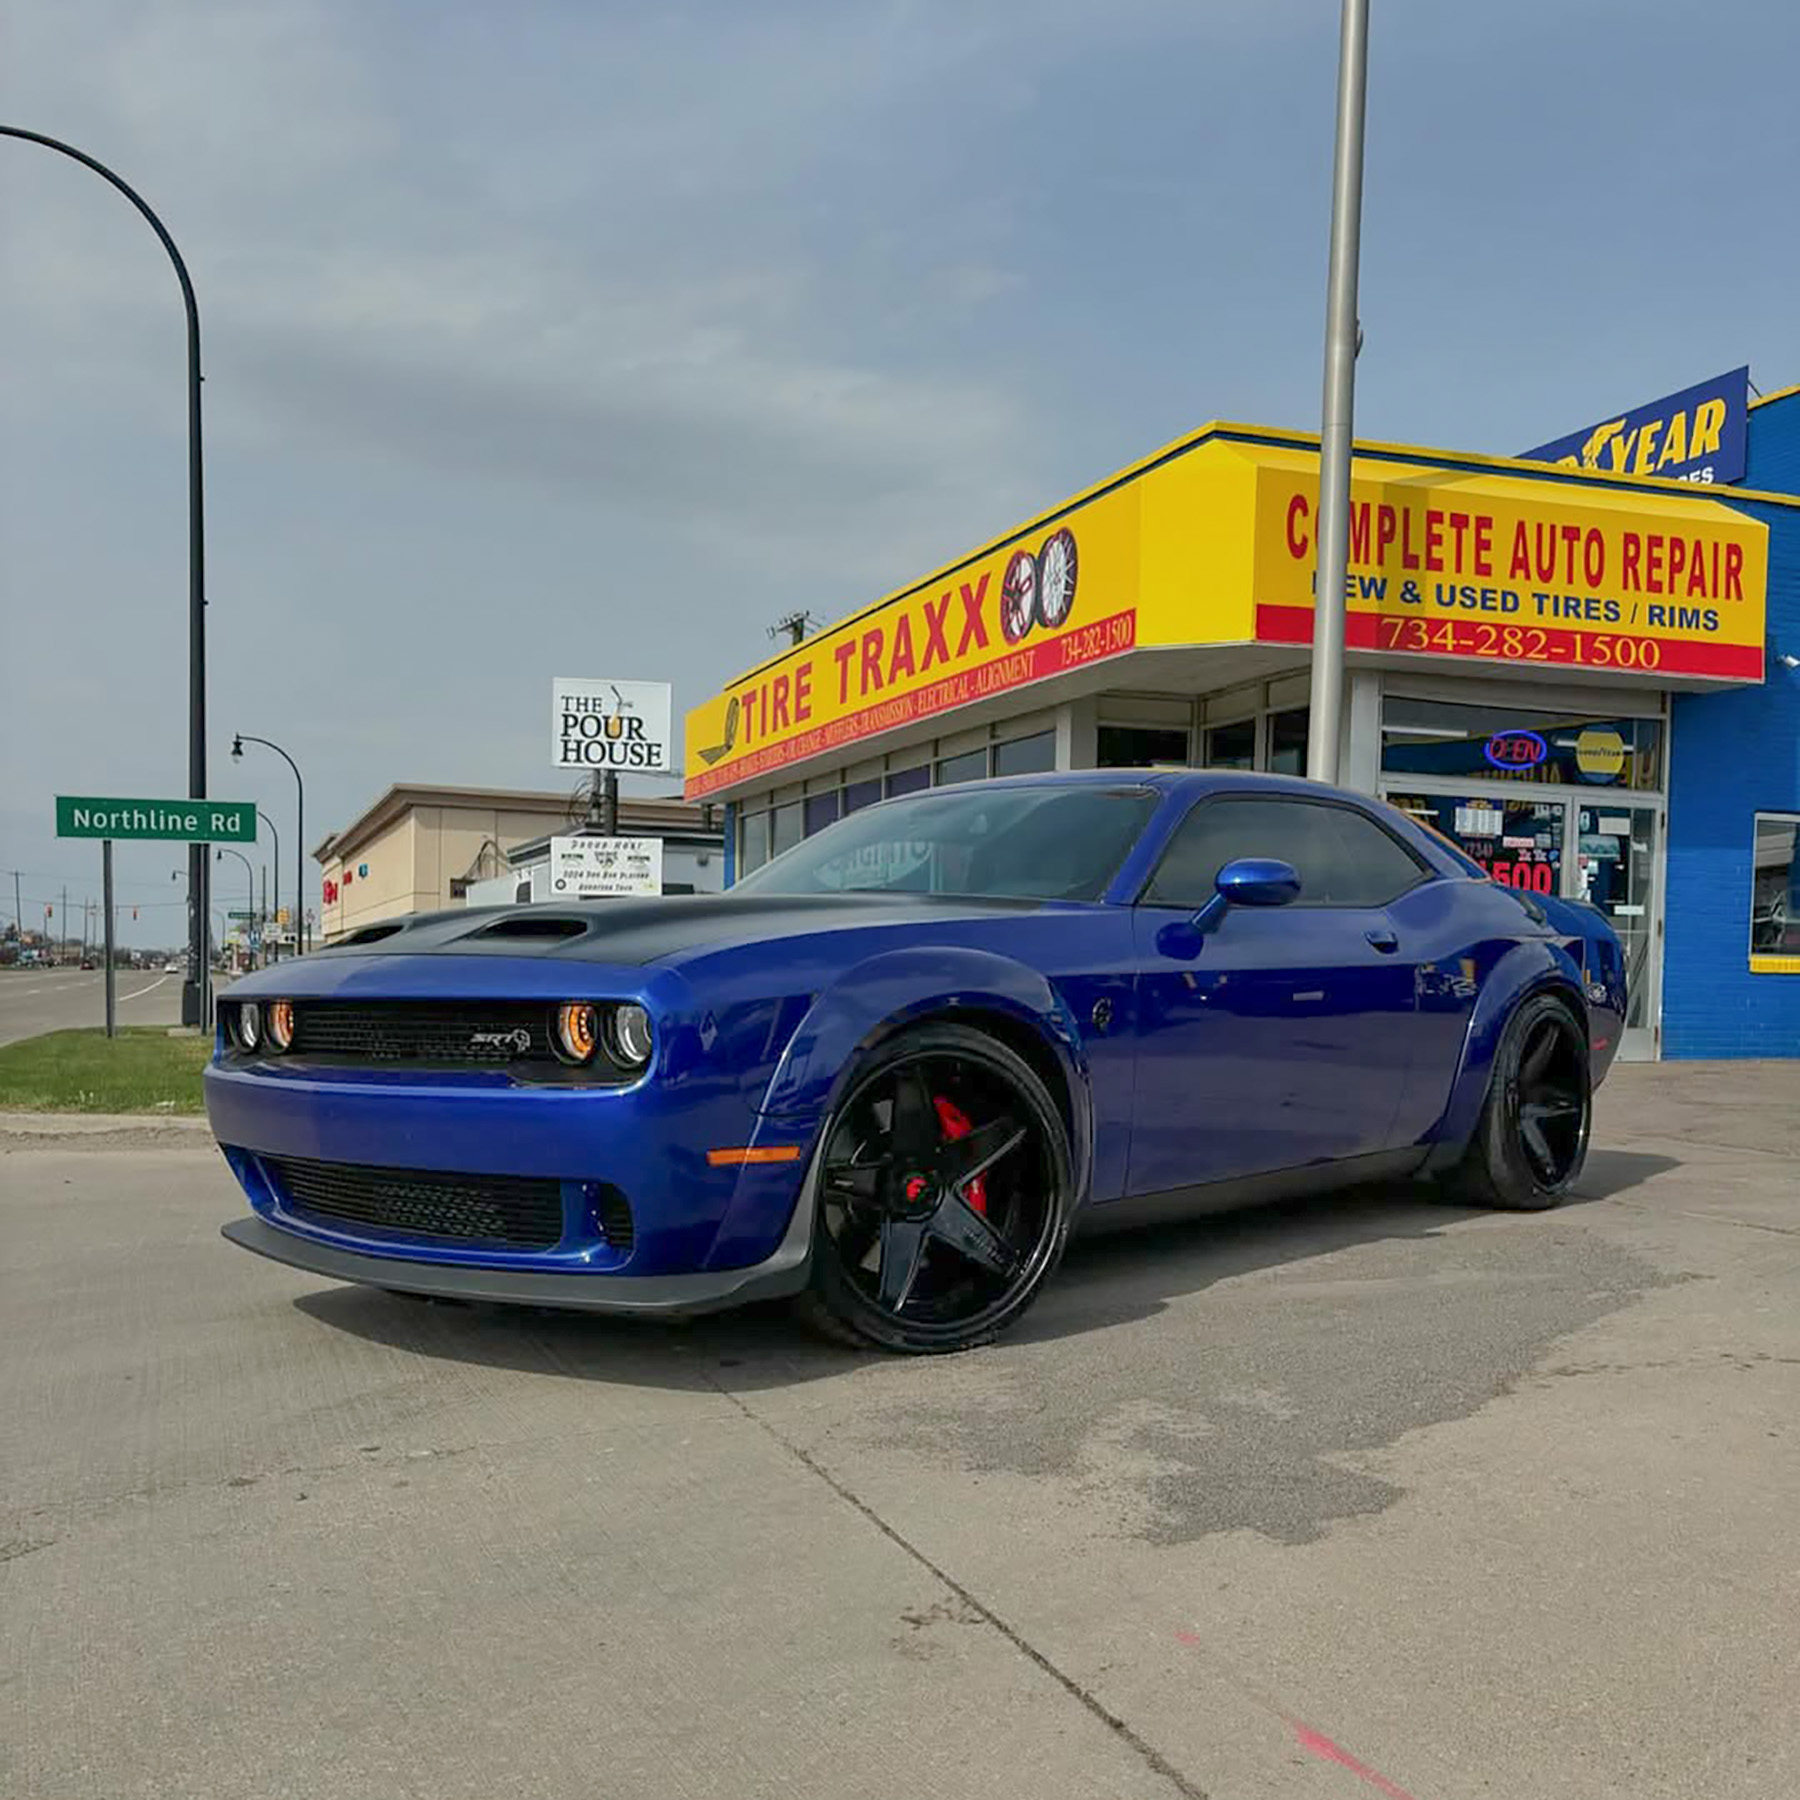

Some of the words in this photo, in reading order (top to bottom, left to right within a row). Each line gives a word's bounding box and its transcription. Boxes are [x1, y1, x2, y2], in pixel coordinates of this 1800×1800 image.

[1287, 494, 1493, 577] CMPLETE
[1509, 520, 1605, 589] AUTO
[1622, 532, 1743, 602] REPAIR
[1313, 570, 1387, 600] EW
[1400, 580, 1421, 604] &
[1436, 584, 1519, 613] USED
[1532, 593, 1621, 622] TIRES
[1648, 605, 1719, 631] RIMS
[742, 661, 812, 744] TIRE
[835, 571, 992, 704] TRAXX
[1061, 614, 1133, 665] 734-282-1500
[1381, 618, 1661, 669] 734-282-1500
[561, 695, 602, 713] THE
[918, 675, 970, 714] ELECTRICAL
[974, 651, 1036, 693] ALIGNMENT
[561, 713, 647, 741] POUR
[1490, 739, 1541, 763] OPEN
[560, 739, 663, 767] HOUSE
[73, 809, 198, 831] Northline
[211, 813, 240, 833] Rd
